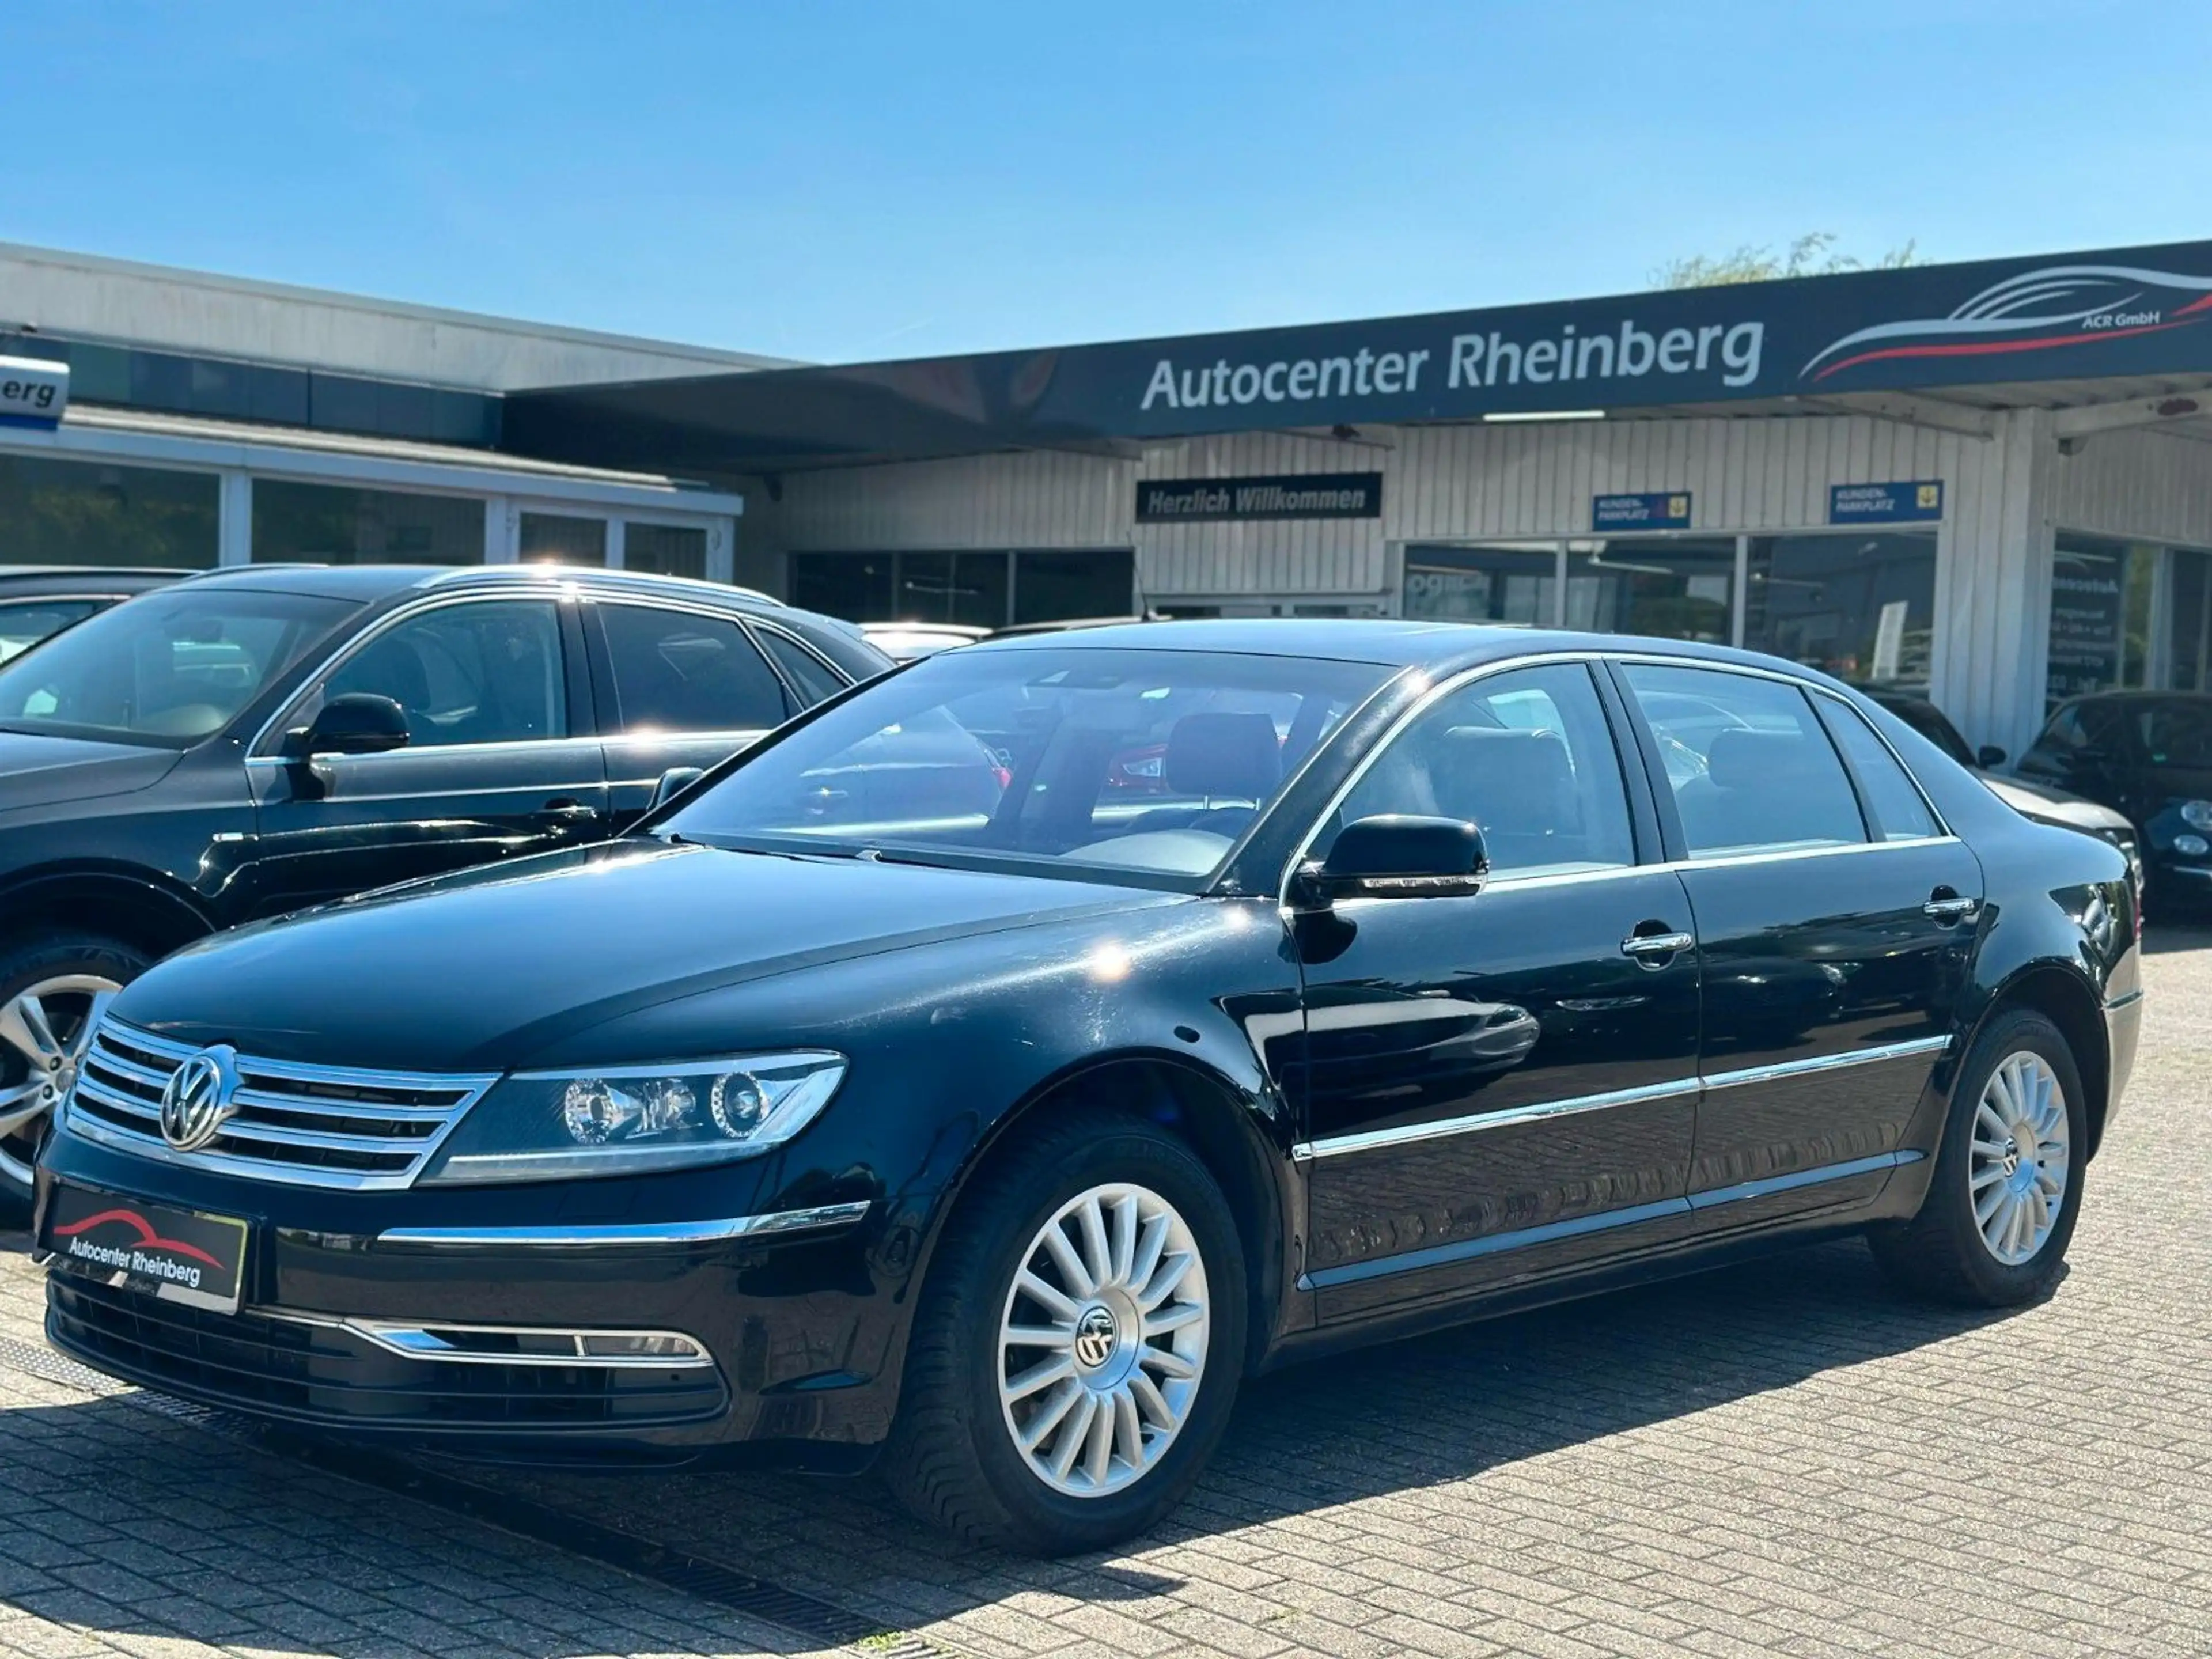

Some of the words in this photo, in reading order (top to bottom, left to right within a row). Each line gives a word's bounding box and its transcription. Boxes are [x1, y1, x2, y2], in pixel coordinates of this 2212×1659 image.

[2081, 315, 2112, 329] ACR
[2115, 311, 2161, 326] GmbH
[1141, 347, 1429, 410] Autocenter
[1448, 320, 1764, 388] Rheinberg
[1147, 487, 1230, 514] Herzlich
[1235, 485, 1366, 512] Willkommen
[69, 1236, 131, 1268] Autocenter
[132, 1251, 201, 1288] Rheinberg
